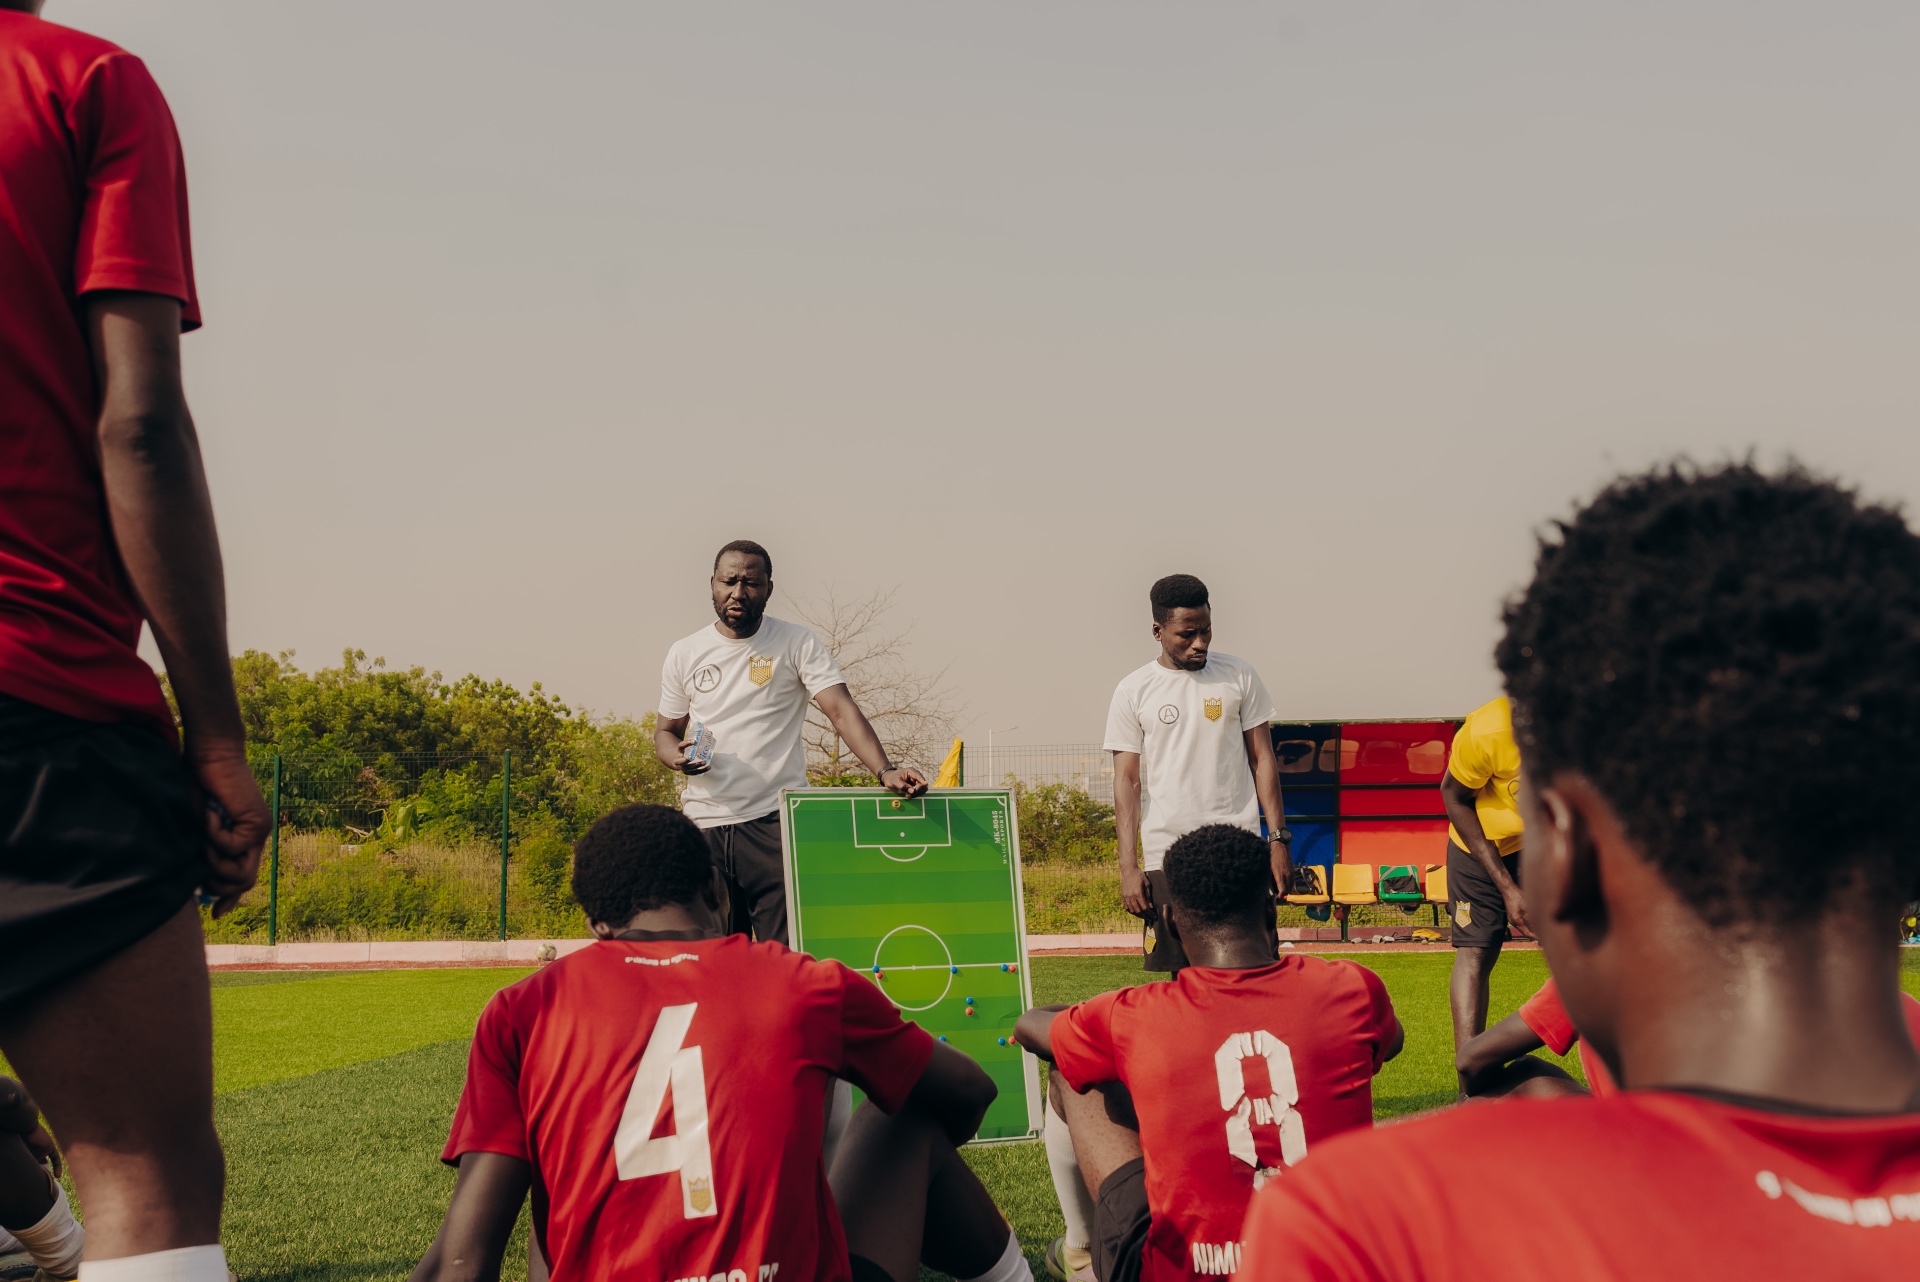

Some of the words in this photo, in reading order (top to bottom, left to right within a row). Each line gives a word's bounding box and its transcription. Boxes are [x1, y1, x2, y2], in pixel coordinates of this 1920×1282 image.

[991, 810, 1001, 844] MK-8045
[614, 1002, 718, 1219] 4
[1214, 1029, 1308, 1192] 8
